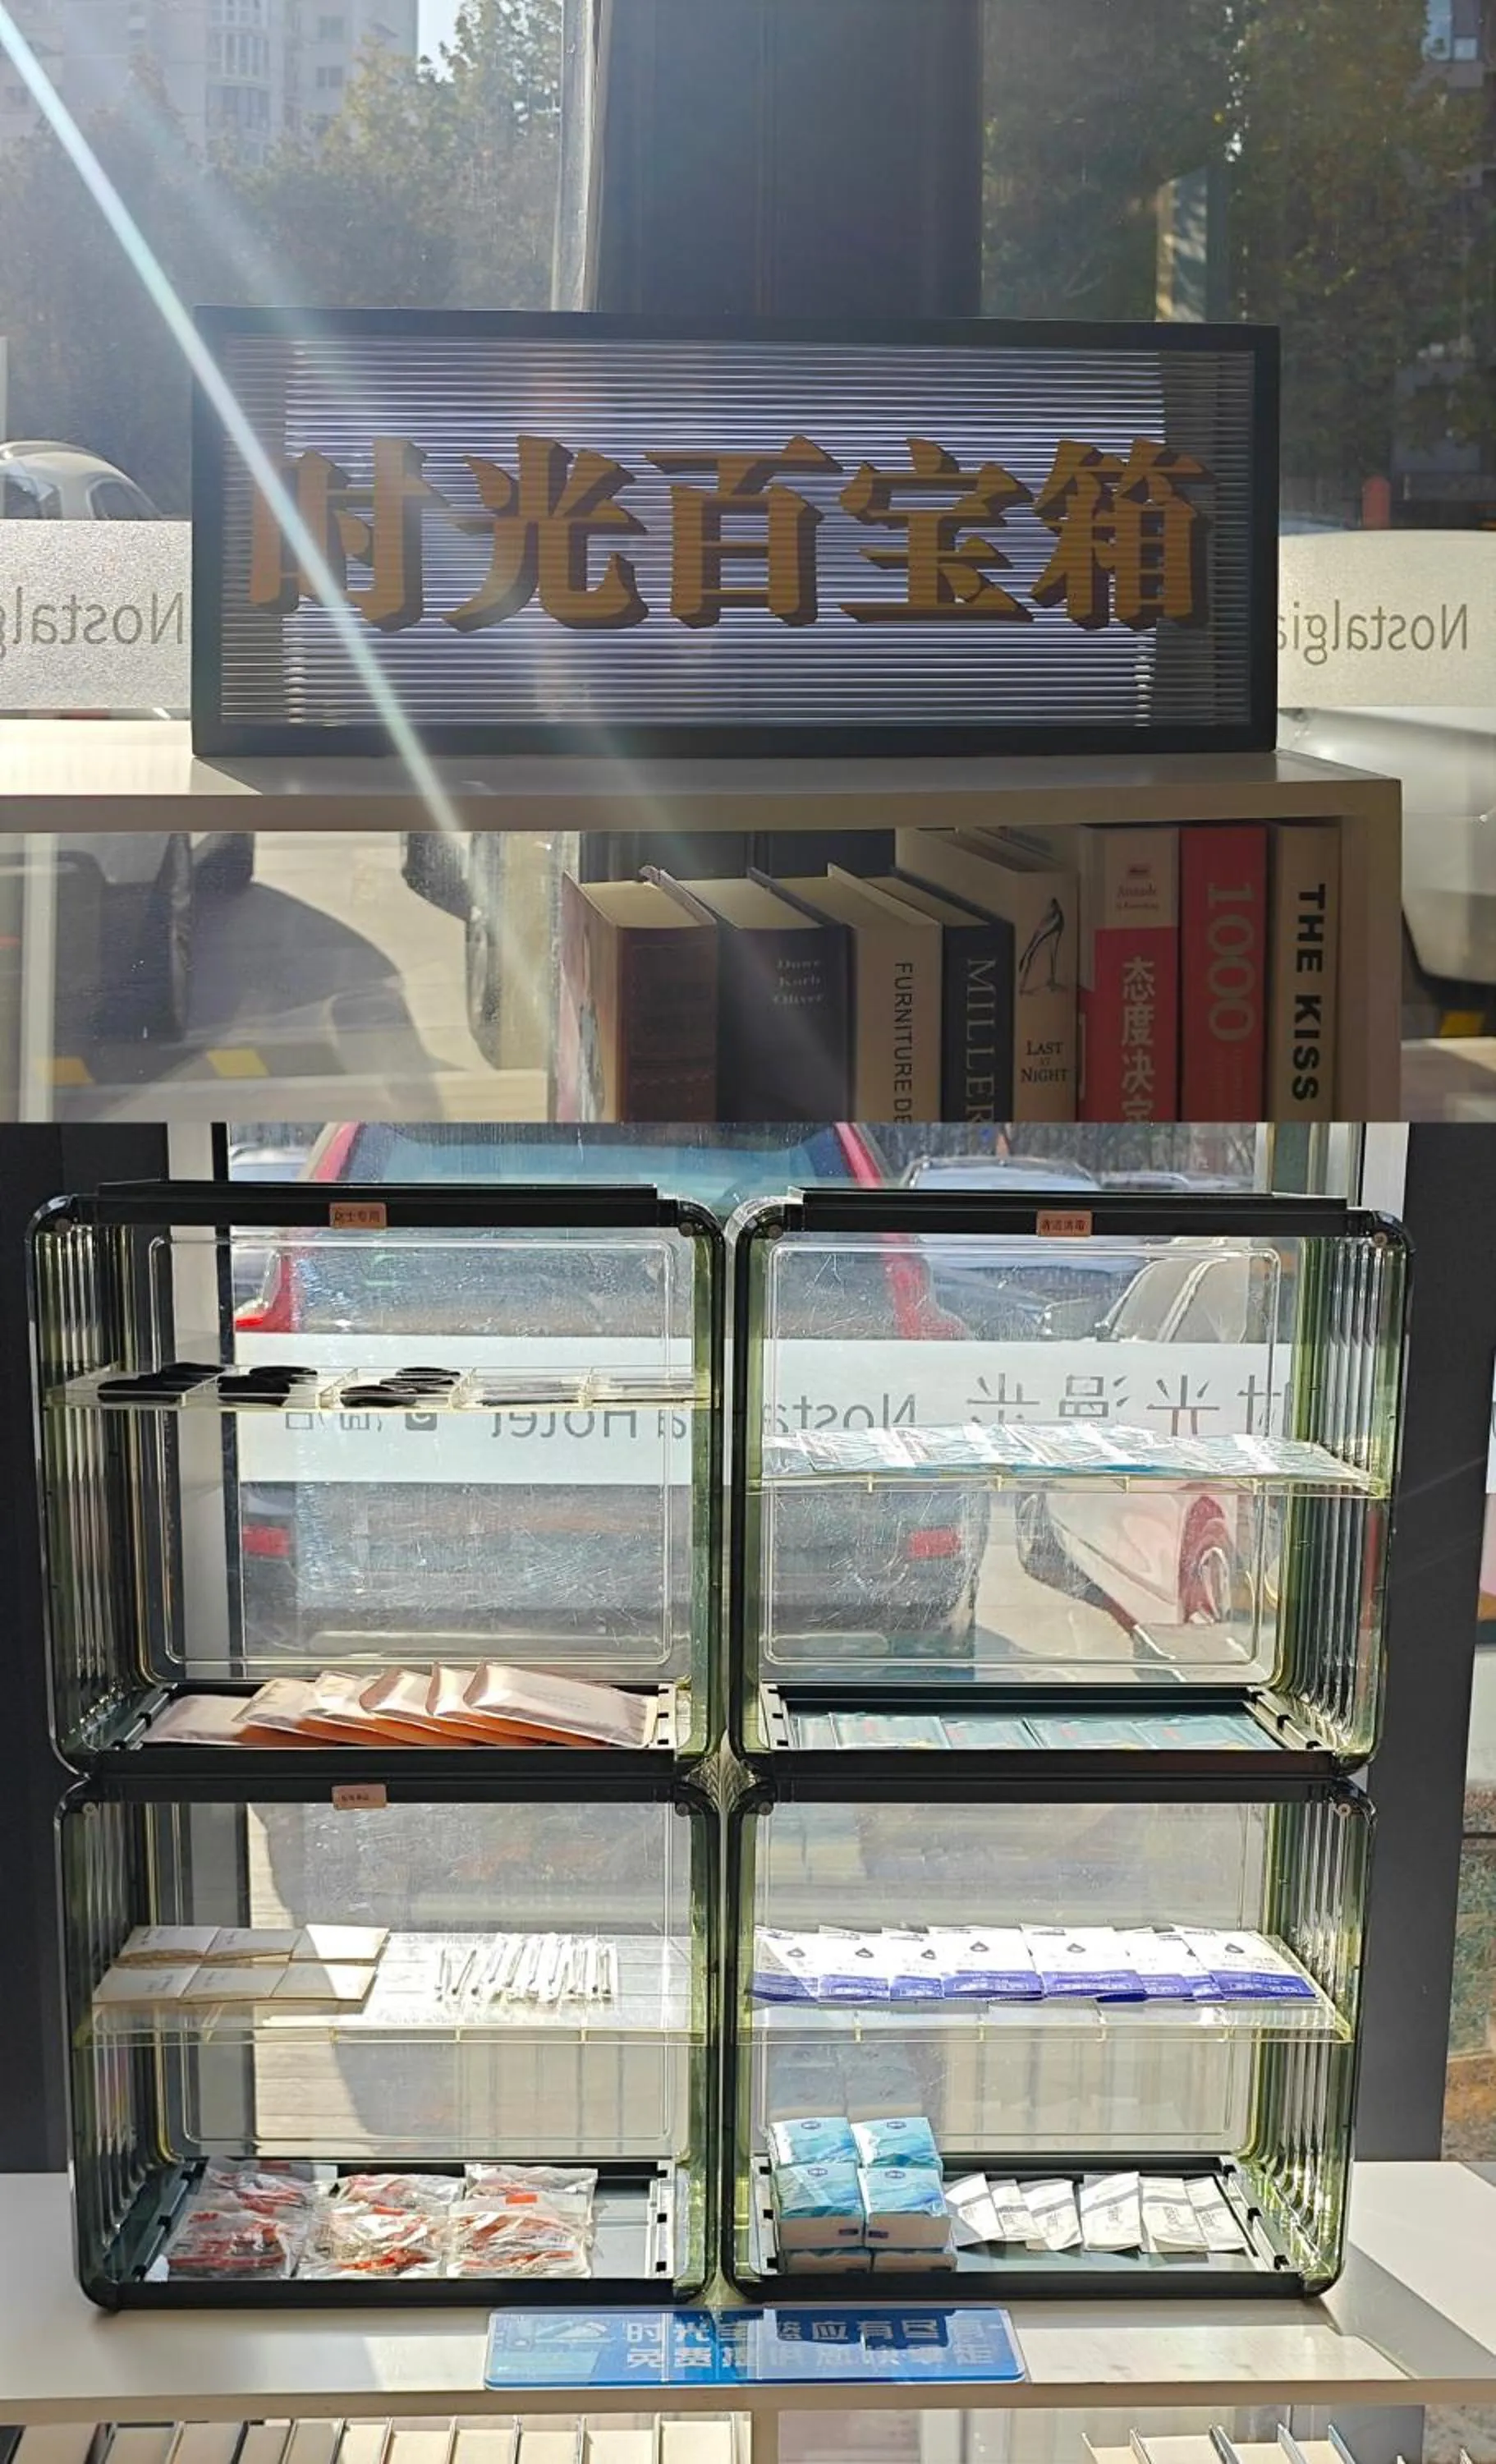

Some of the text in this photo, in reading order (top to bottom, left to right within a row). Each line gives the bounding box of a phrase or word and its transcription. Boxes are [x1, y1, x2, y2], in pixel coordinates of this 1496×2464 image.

[248, 434, 1214, 631] 时光百宝箱
[894, 962, 912, 1092] FURNITURE
[966, 958, 995, 1123] MILLER
[1207, 882, 1255, 1041] 1000
[1292, 883, 1326, 1101] THE KISS
